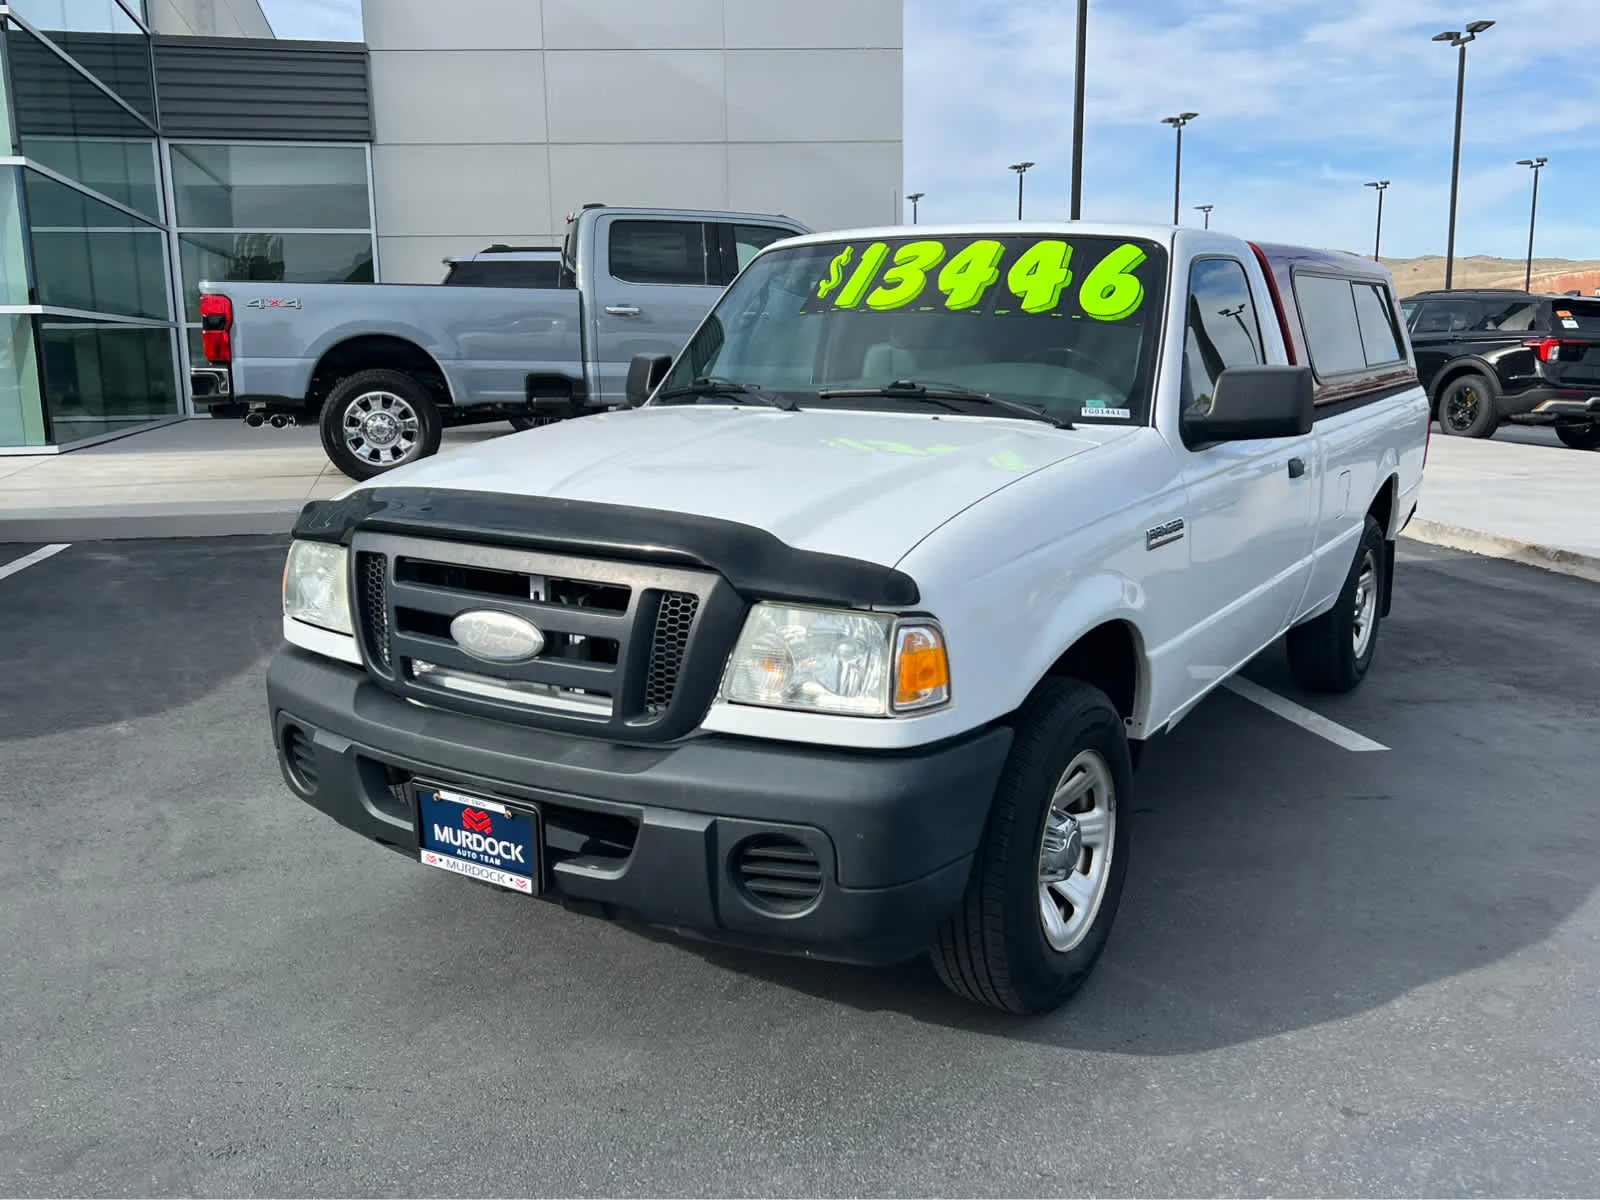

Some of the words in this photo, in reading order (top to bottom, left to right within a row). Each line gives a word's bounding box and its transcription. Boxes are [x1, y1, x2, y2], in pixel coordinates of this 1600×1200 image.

[817, 240, 1147, 321] $13446
[434, 823, 525, 864] MURDOCK
[456, 849, 477, 859] AUTO
[480, 854, 501, 865] TEAM
[446, 860, 506, 883] MURDOCK
